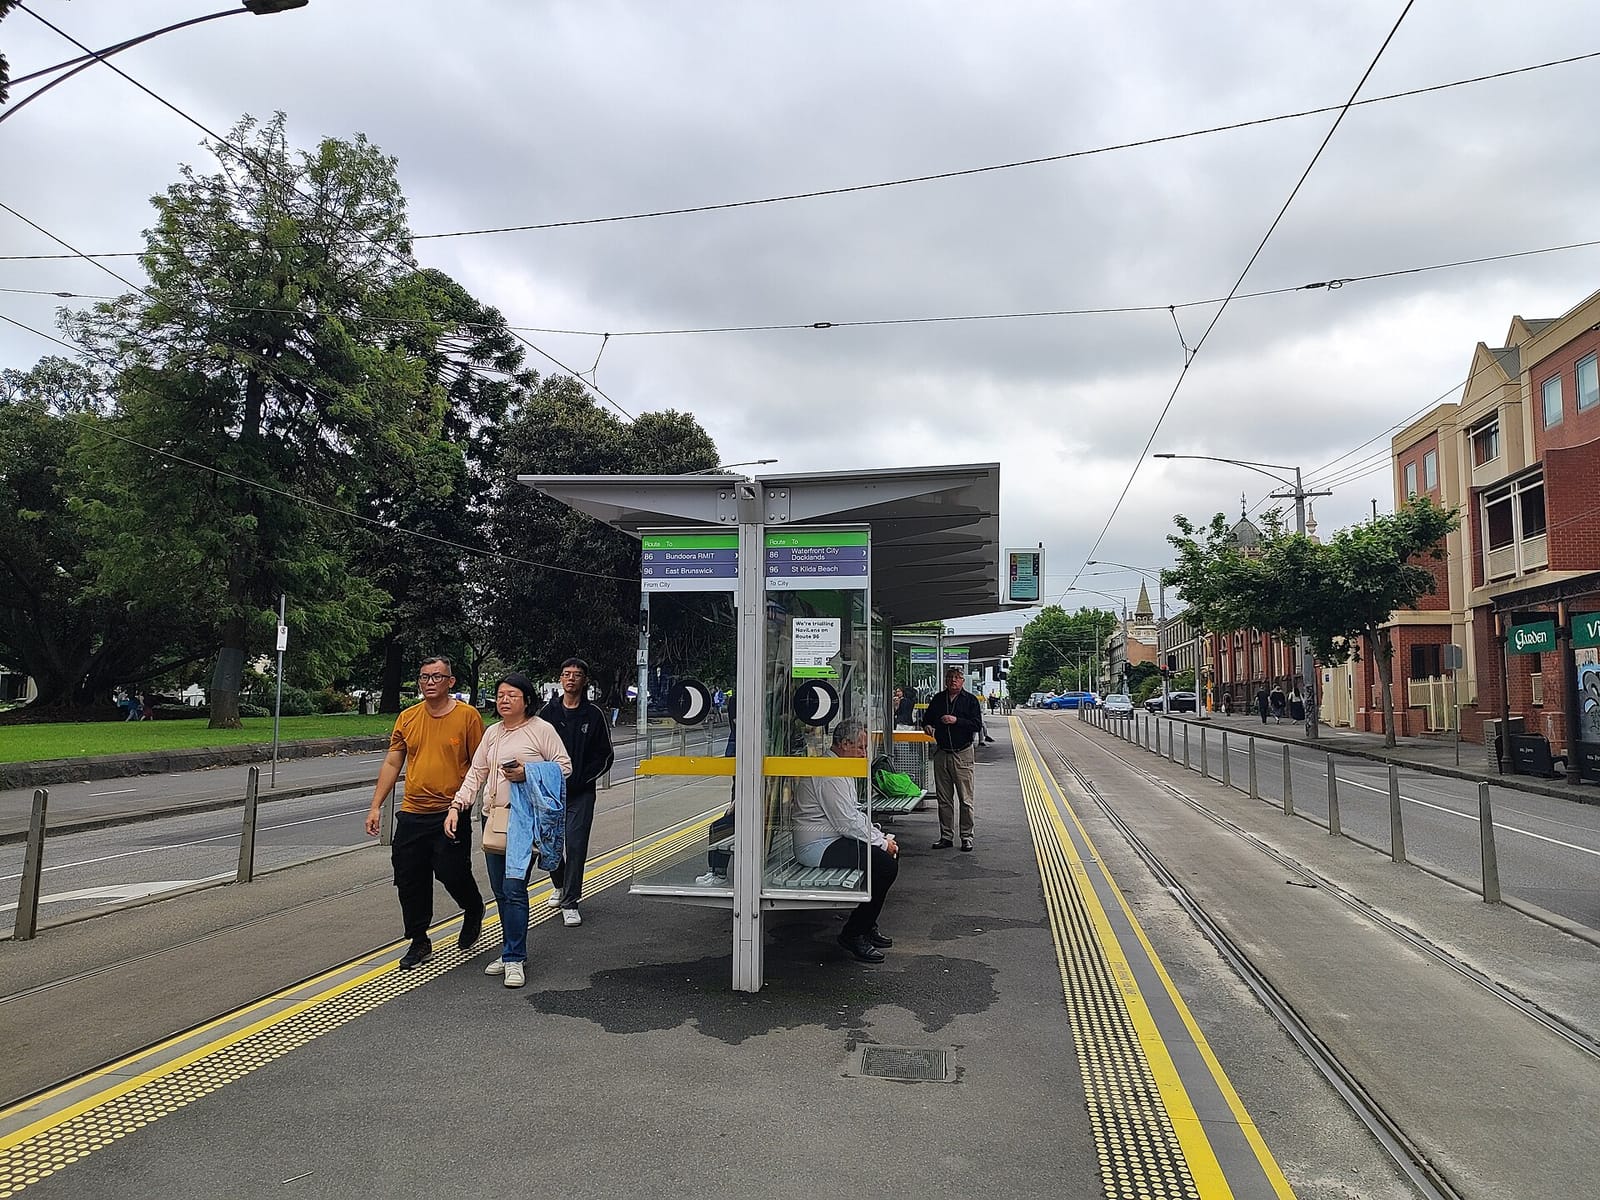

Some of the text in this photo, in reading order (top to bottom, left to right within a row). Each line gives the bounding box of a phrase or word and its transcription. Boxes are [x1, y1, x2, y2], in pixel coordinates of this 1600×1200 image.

[769, 547, 840, 559] 86 Waterfront City
[665, 567, 680, 575] East
[791, 565, 799, 573] St
